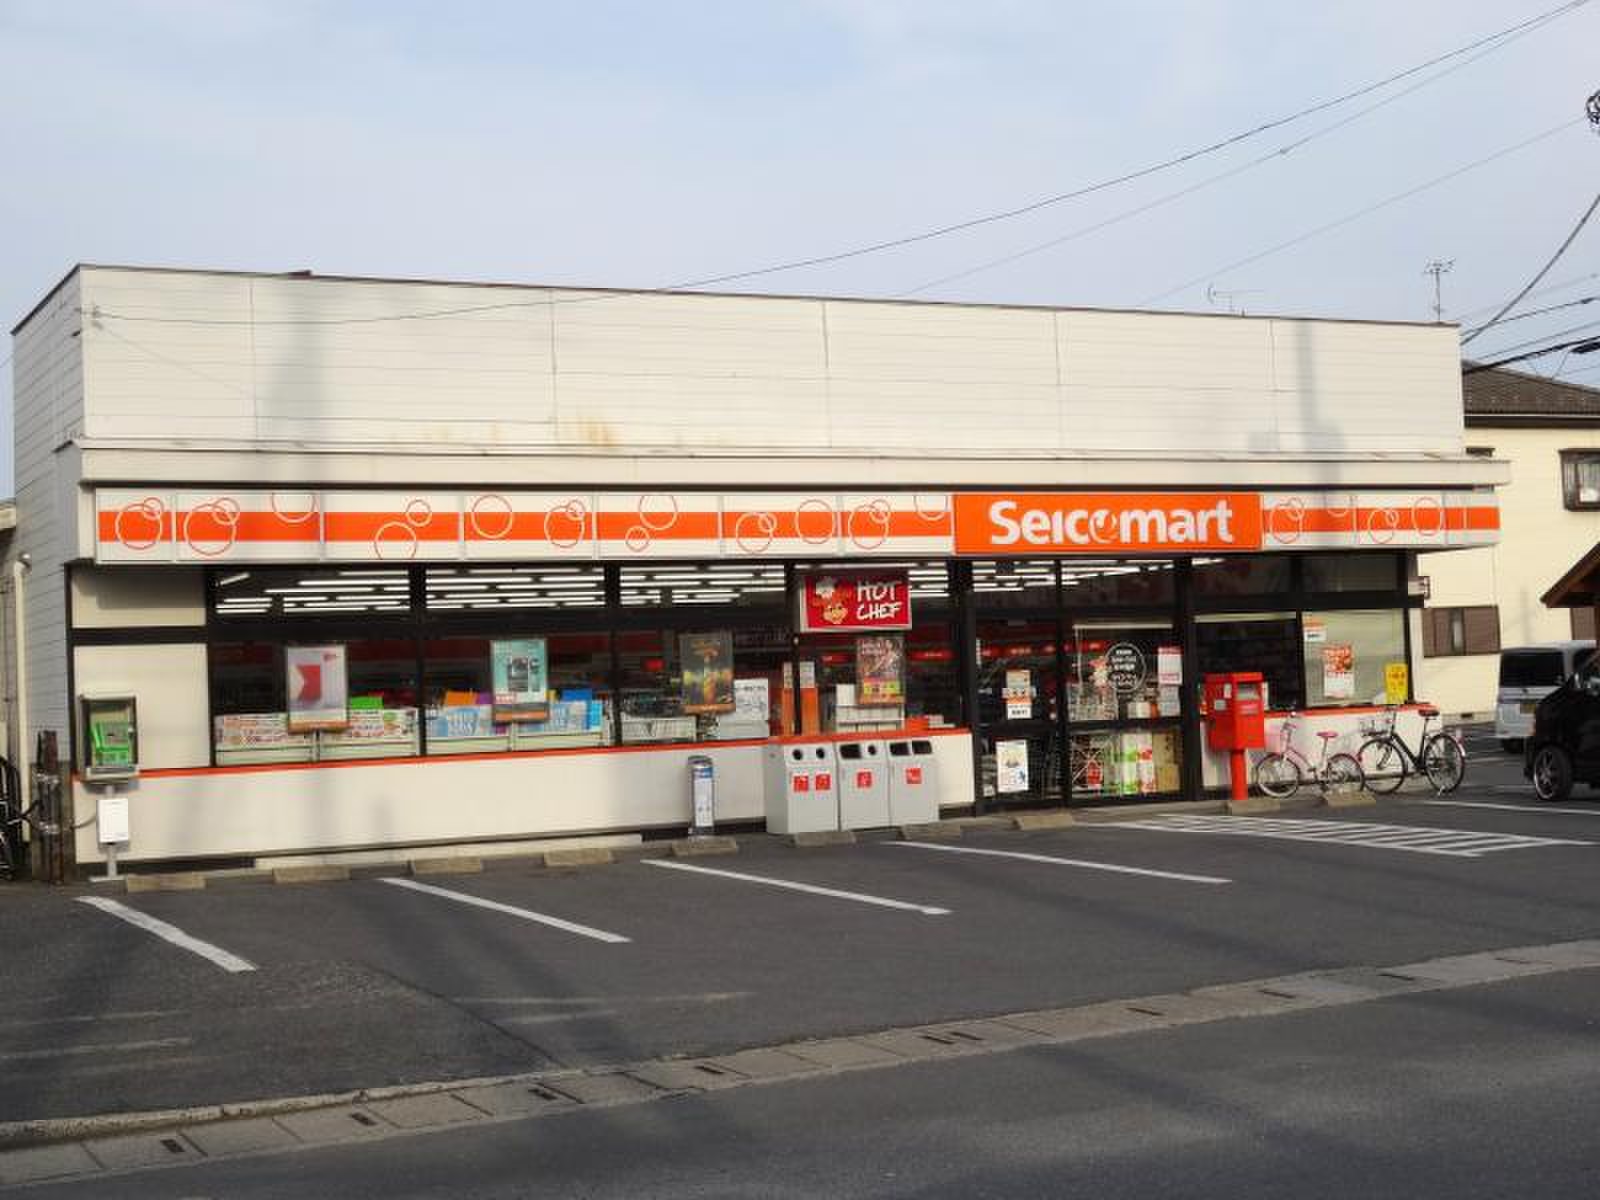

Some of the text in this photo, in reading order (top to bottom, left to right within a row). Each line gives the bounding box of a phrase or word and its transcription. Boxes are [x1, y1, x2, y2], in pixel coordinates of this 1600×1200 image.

[989, 499, 1233, 545] Seicomart
[857, 580, 902, 602] HOT
[857, 601, 902, 620] CHEF
